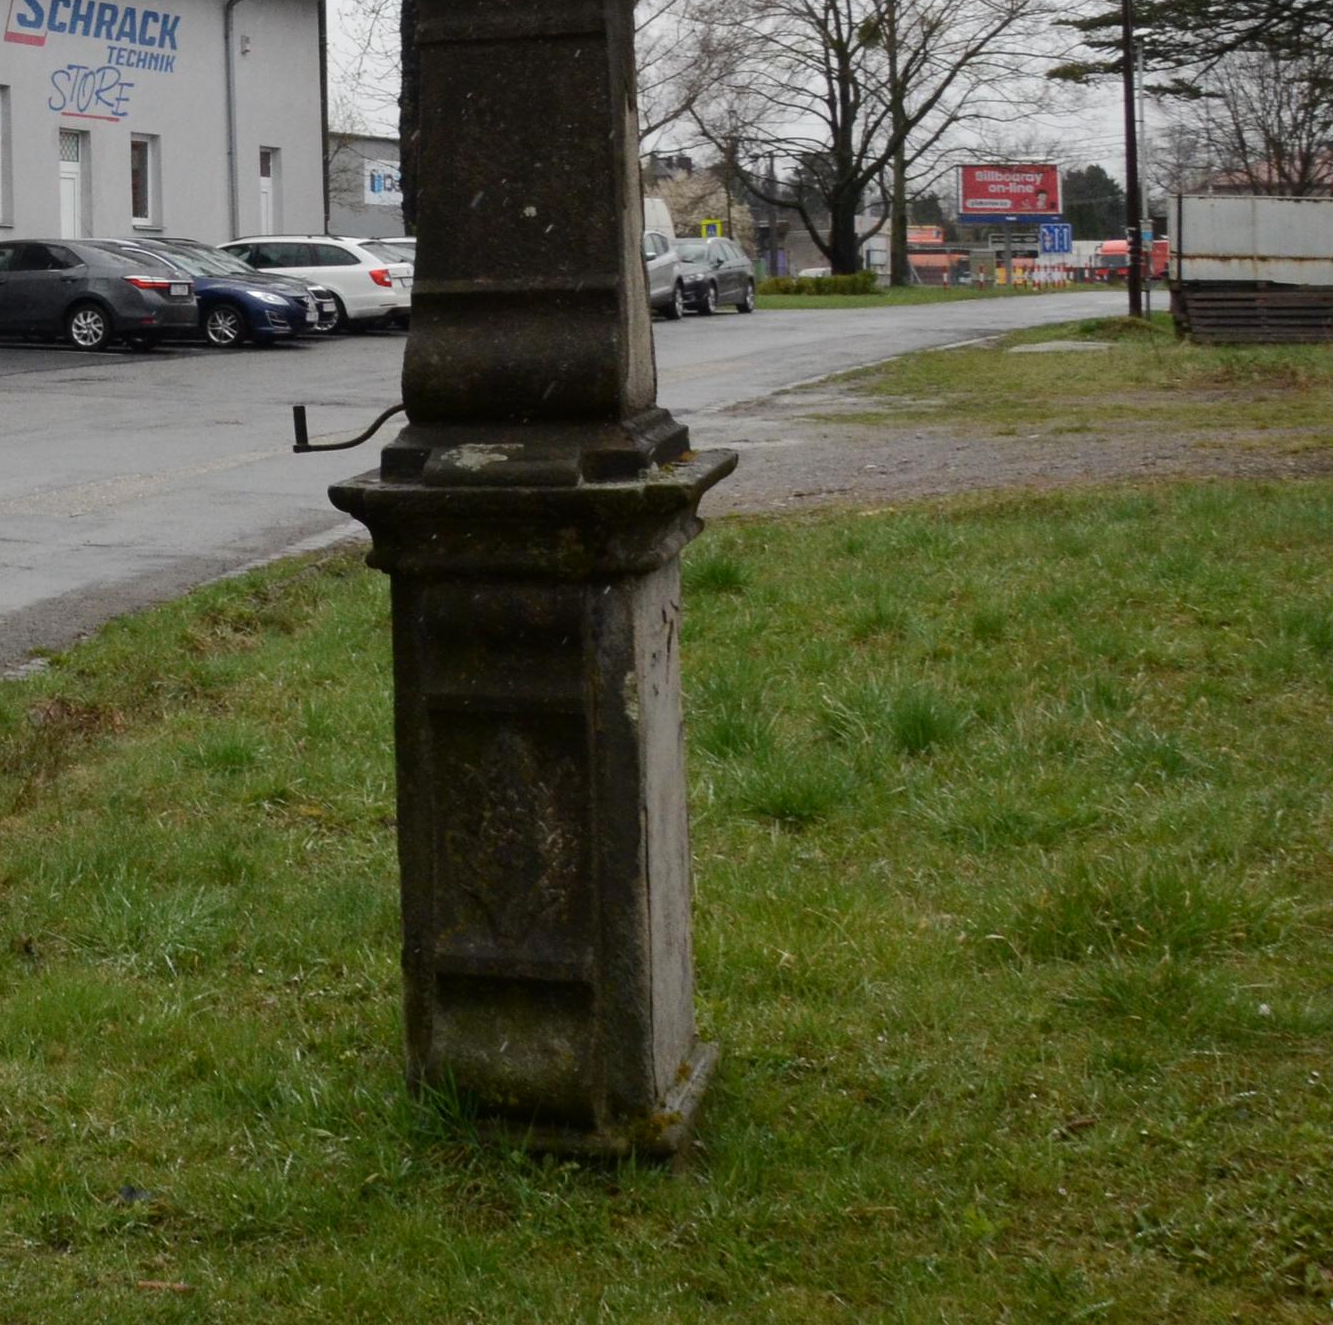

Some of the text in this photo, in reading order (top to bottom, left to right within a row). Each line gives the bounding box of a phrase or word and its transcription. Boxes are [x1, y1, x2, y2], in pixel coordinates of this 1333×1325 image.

[107, 45, 176, 73] TECHNIK
[48, 63, 135, 116] STORE
[988, 182, 1034, 193] on-line
